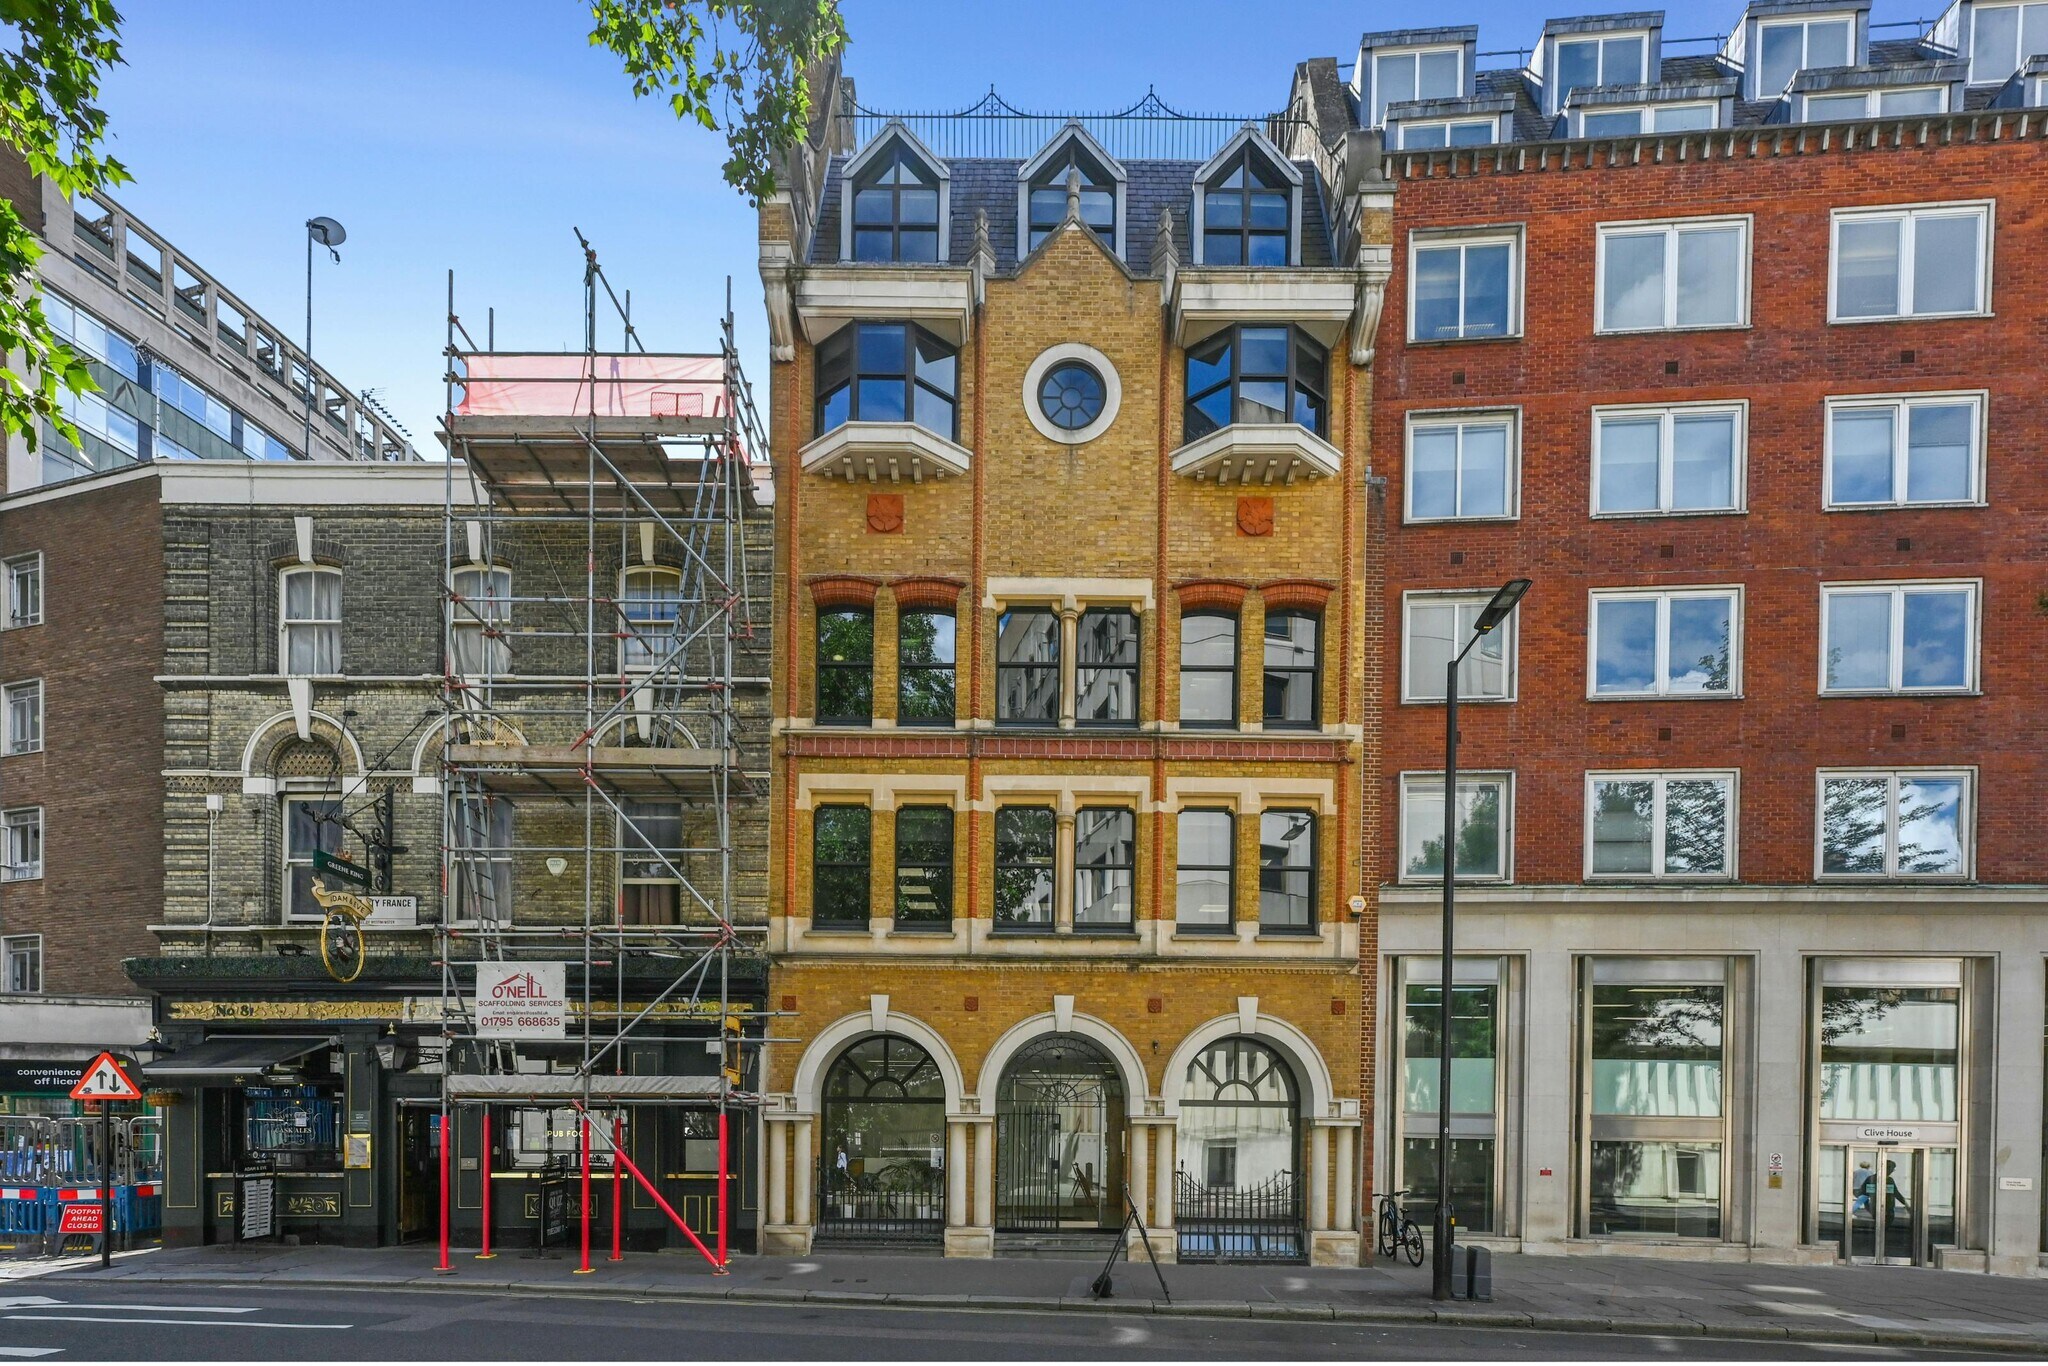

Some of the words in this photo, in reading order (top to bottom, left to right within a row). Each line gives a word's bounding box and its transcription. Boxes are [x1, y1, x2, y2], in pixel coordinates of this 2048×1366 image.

[327, 861, 349, 875] GREENE
[350, 867, 364, 880] KING
[353, 901, 366, 913] EVE
[382, 899, 412, 907] FRANCE
[492, 972, 547, 998] O'NEILL
[215, 1004, 235, 1017] No
[481, 1017, 513, 1026] 01795
[517, 1017, 560, 1026] 668635
[17, 1068, 82, 1076] convenience
[34, 1077, 51, 1085] off
[53, 1077, 80, 1085] licen
[547, 1130, 564, 1138] PUB
[1864, 1128, 1885, 1137] Clive
[1886, 1129, 1913, 1138] House
